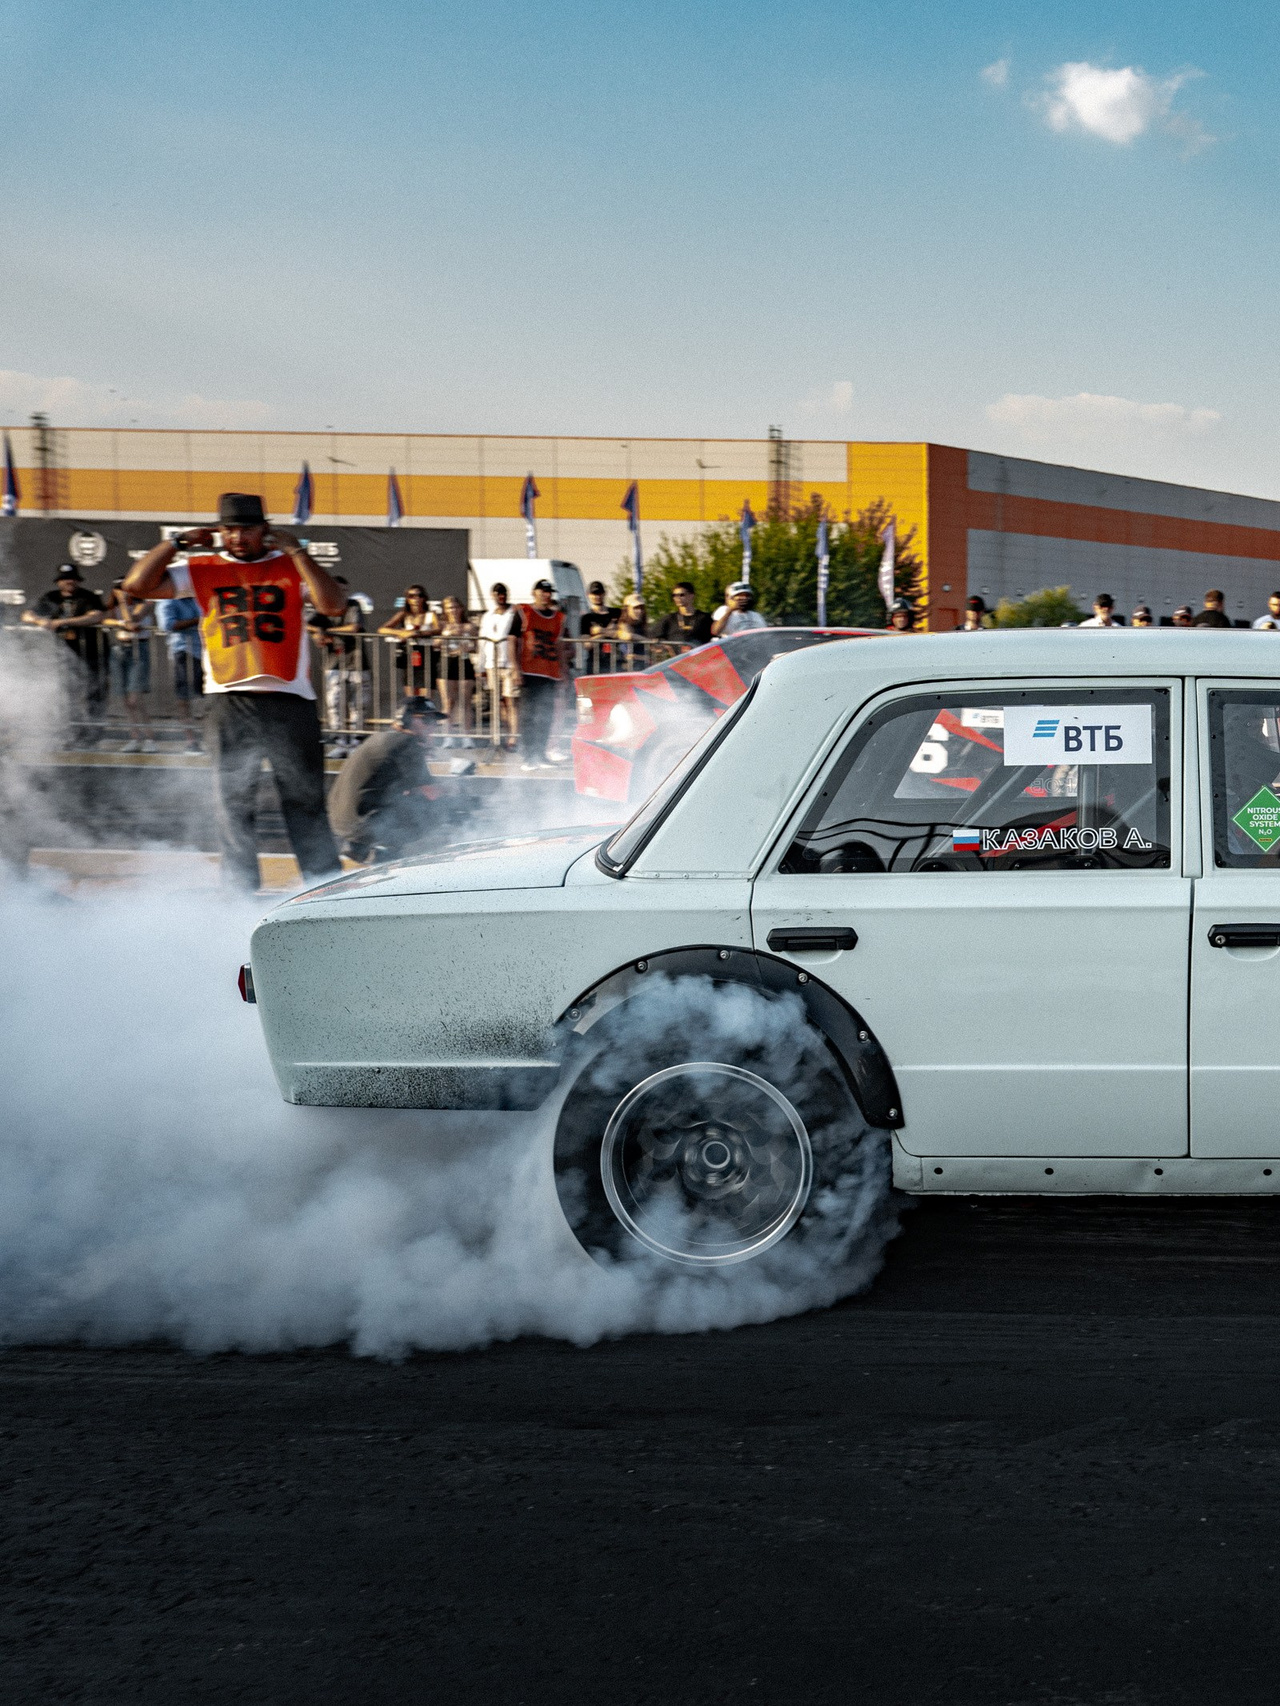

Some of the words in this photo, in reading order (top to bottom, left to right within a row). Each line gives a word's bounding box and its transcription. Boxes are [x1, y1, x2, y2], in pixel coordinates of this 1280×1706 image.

[1064, 725, 1123, 752] ВТБ
[1249, 820, 1280, 828] SYSTEM
[982, 828, 1118, 850] КАЗАКОВ
[1123, 827, 1152, 849] А.
